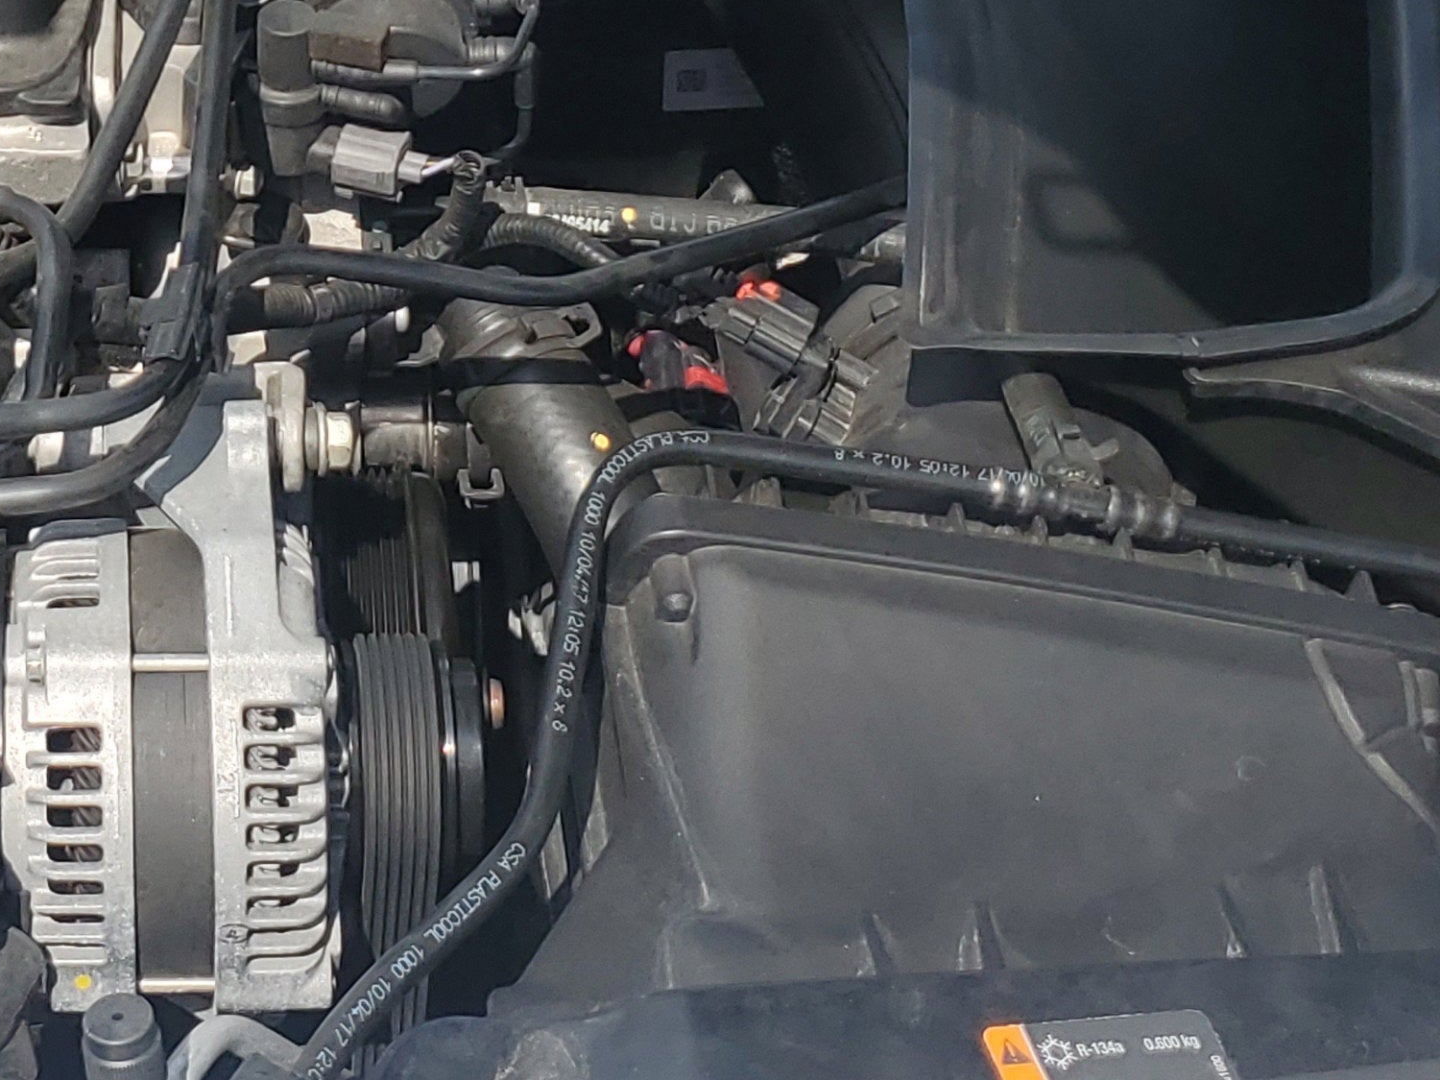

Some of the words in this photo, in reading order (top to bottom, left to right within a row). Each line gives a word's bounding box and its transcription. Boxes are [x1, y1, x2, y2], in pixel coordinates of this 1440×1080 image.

[597, 430, 674, 485] PLASTICOOL
[872, 453, 910, 470] 10.2
[920, 459, 969, 478] 12:05
[584, 491, 607, 526] 1000
[563, 608, 586, 657] 12:05
[556, 661, 576, 699] 10.2
[423, 869, 502, 944] PLASTICOOL
[391, 943, 425, 979] 1000
[334, 977, 391, 1048] 10/04/17
[1076, 1040, 1125, 1058] R-134a
[1143, 1034, 1180, 1052] 0.600
[1180, 1032, 1202, 1050] kg
